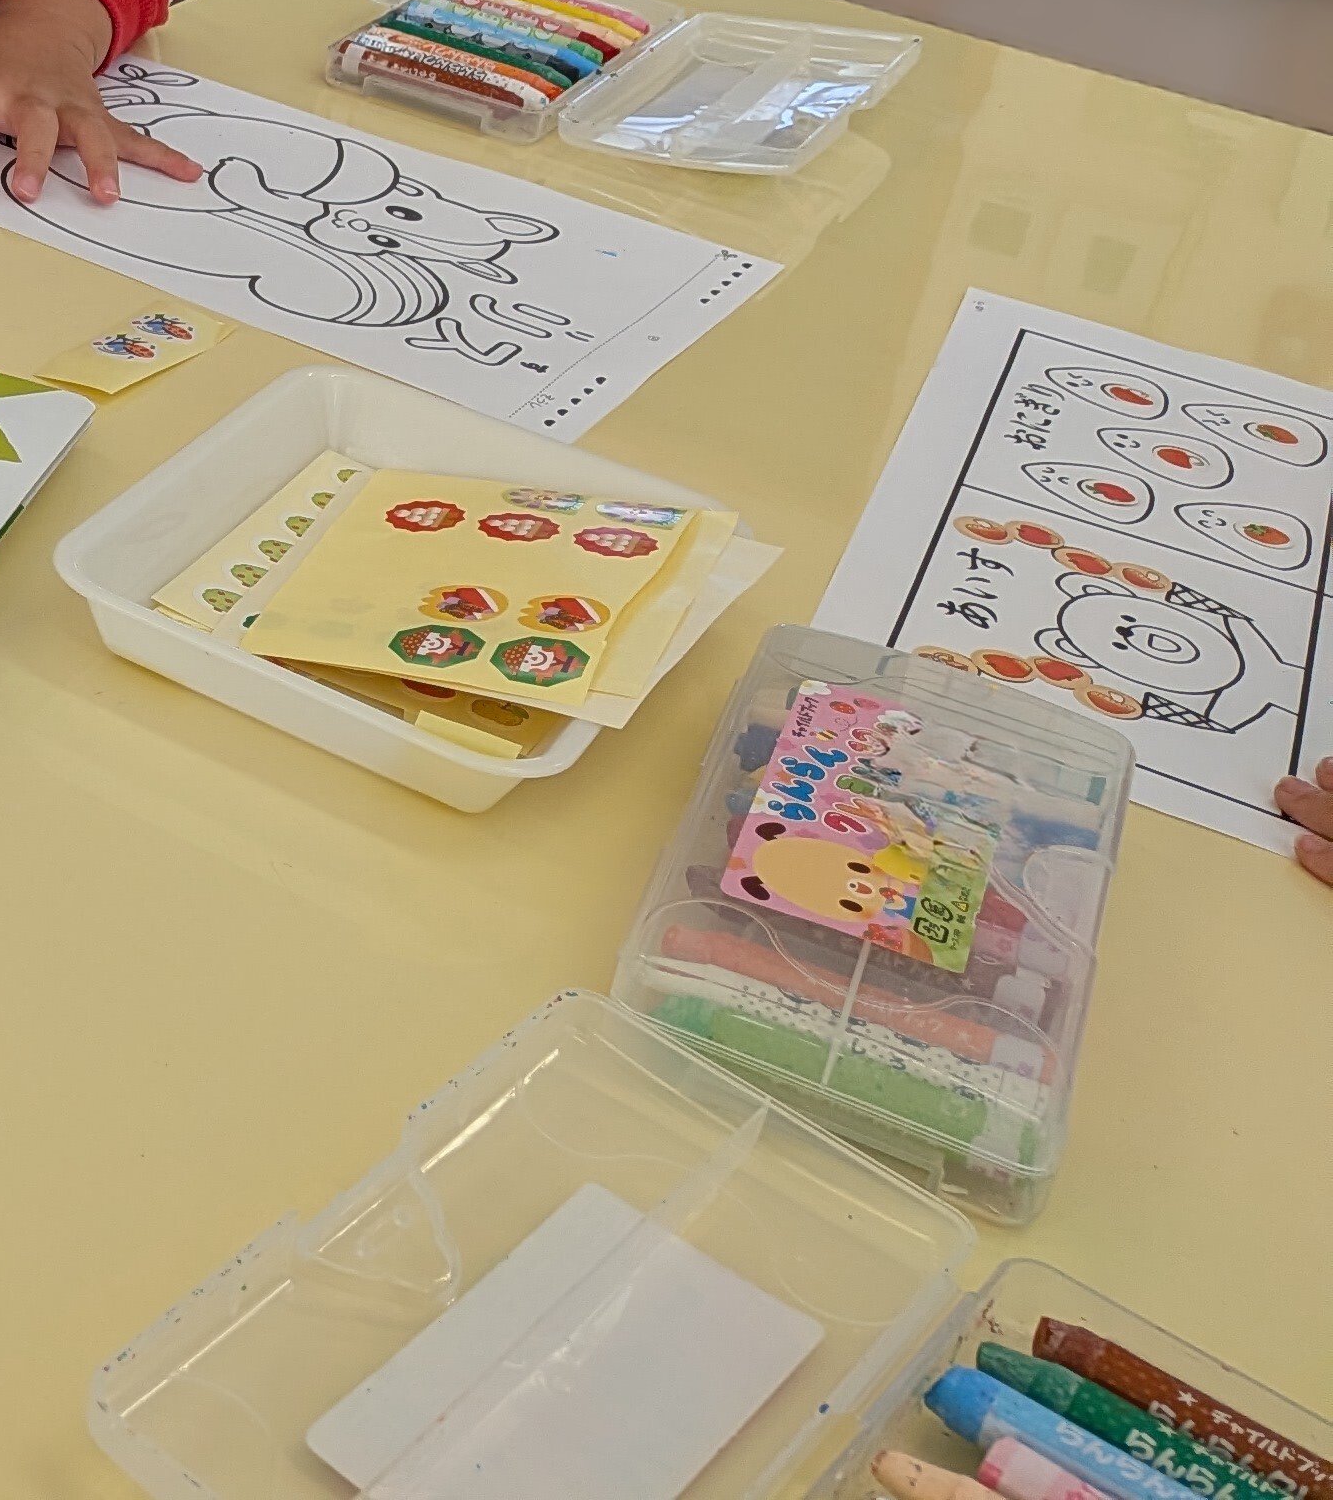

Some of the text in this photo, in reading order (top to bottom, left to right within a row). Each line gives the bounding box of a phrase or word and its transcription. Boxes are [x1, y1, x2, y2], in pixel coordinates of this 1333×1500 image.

[1004, 383, 1066, 450] おにぎり
[937, 548, 1014, 629] あいす
[766, 744, 850, 822] らんらん
[1211, 1408, 1333, 1482] チャイルドブッ
